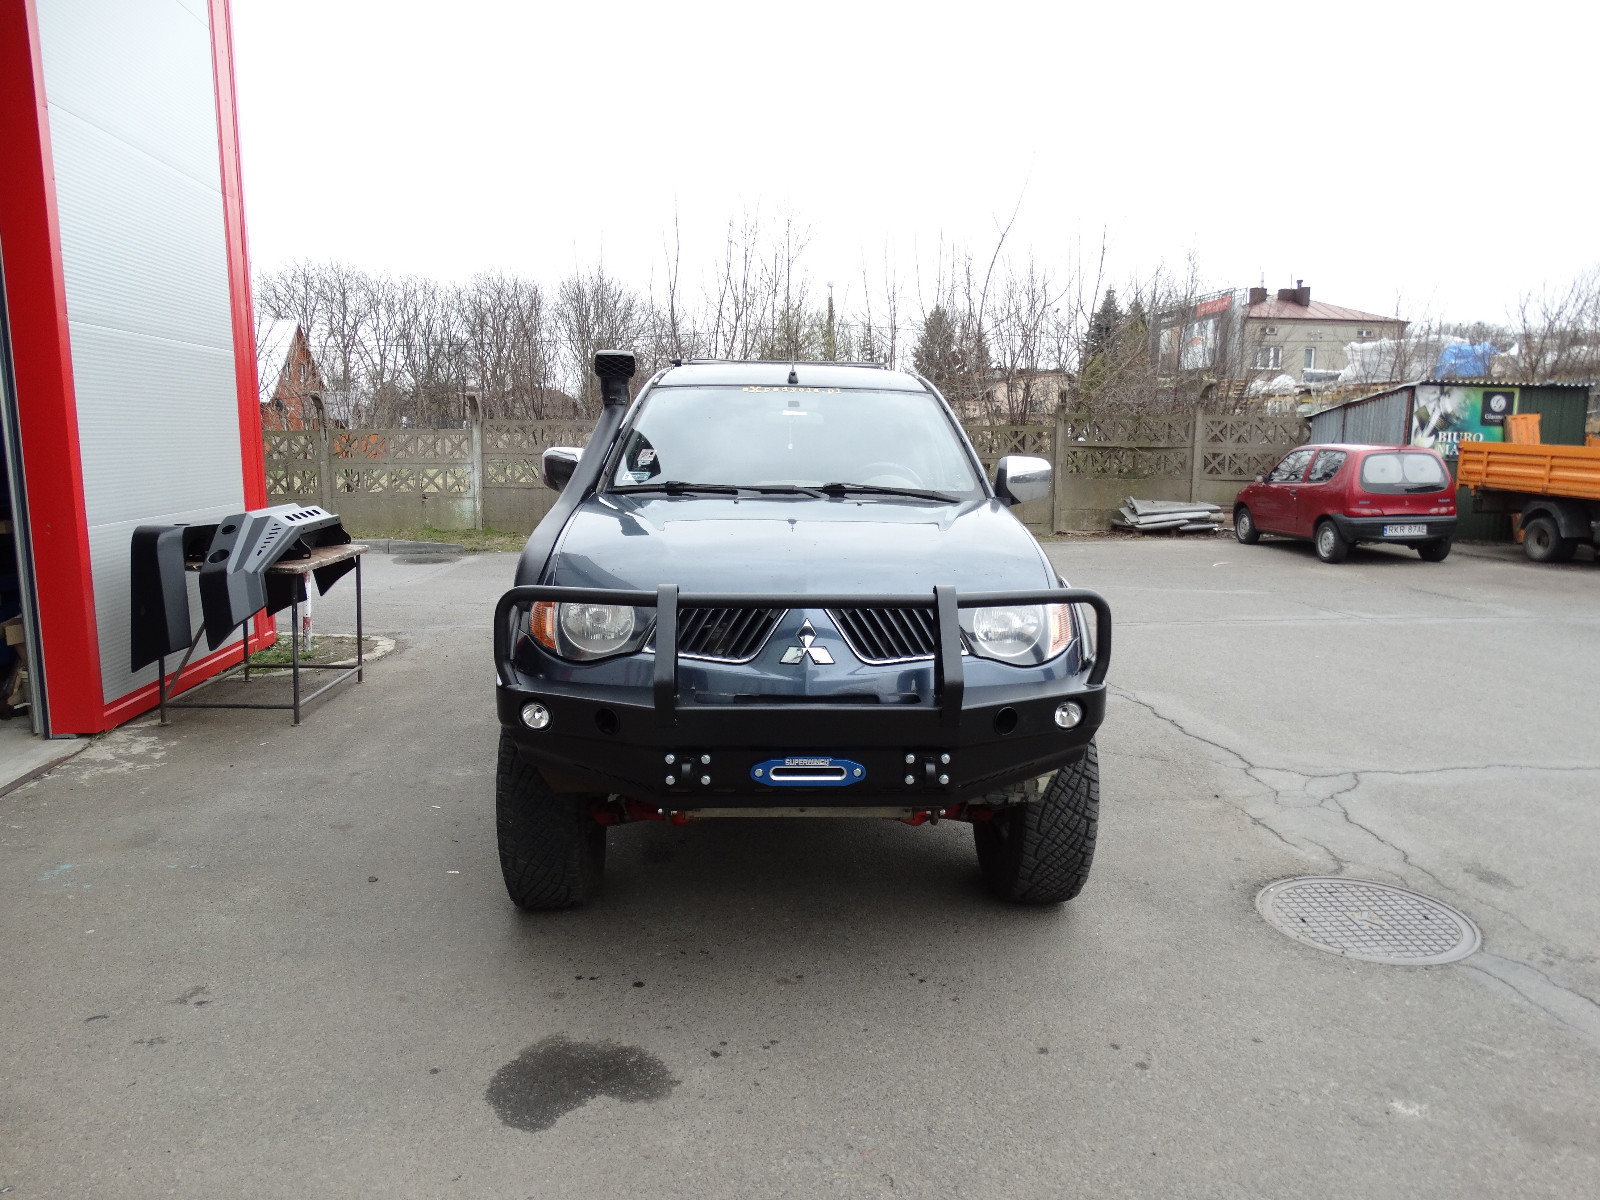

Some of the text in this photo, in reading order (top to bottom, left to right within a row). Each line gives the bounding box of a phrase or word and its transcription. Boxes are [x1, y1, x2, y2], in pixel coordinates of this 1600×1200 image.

[1438, 431, 1484, 443] BIURO
[1388, 525, 1405, 534] RKR
[784, 758, 829, 766] SUPERWINCH
